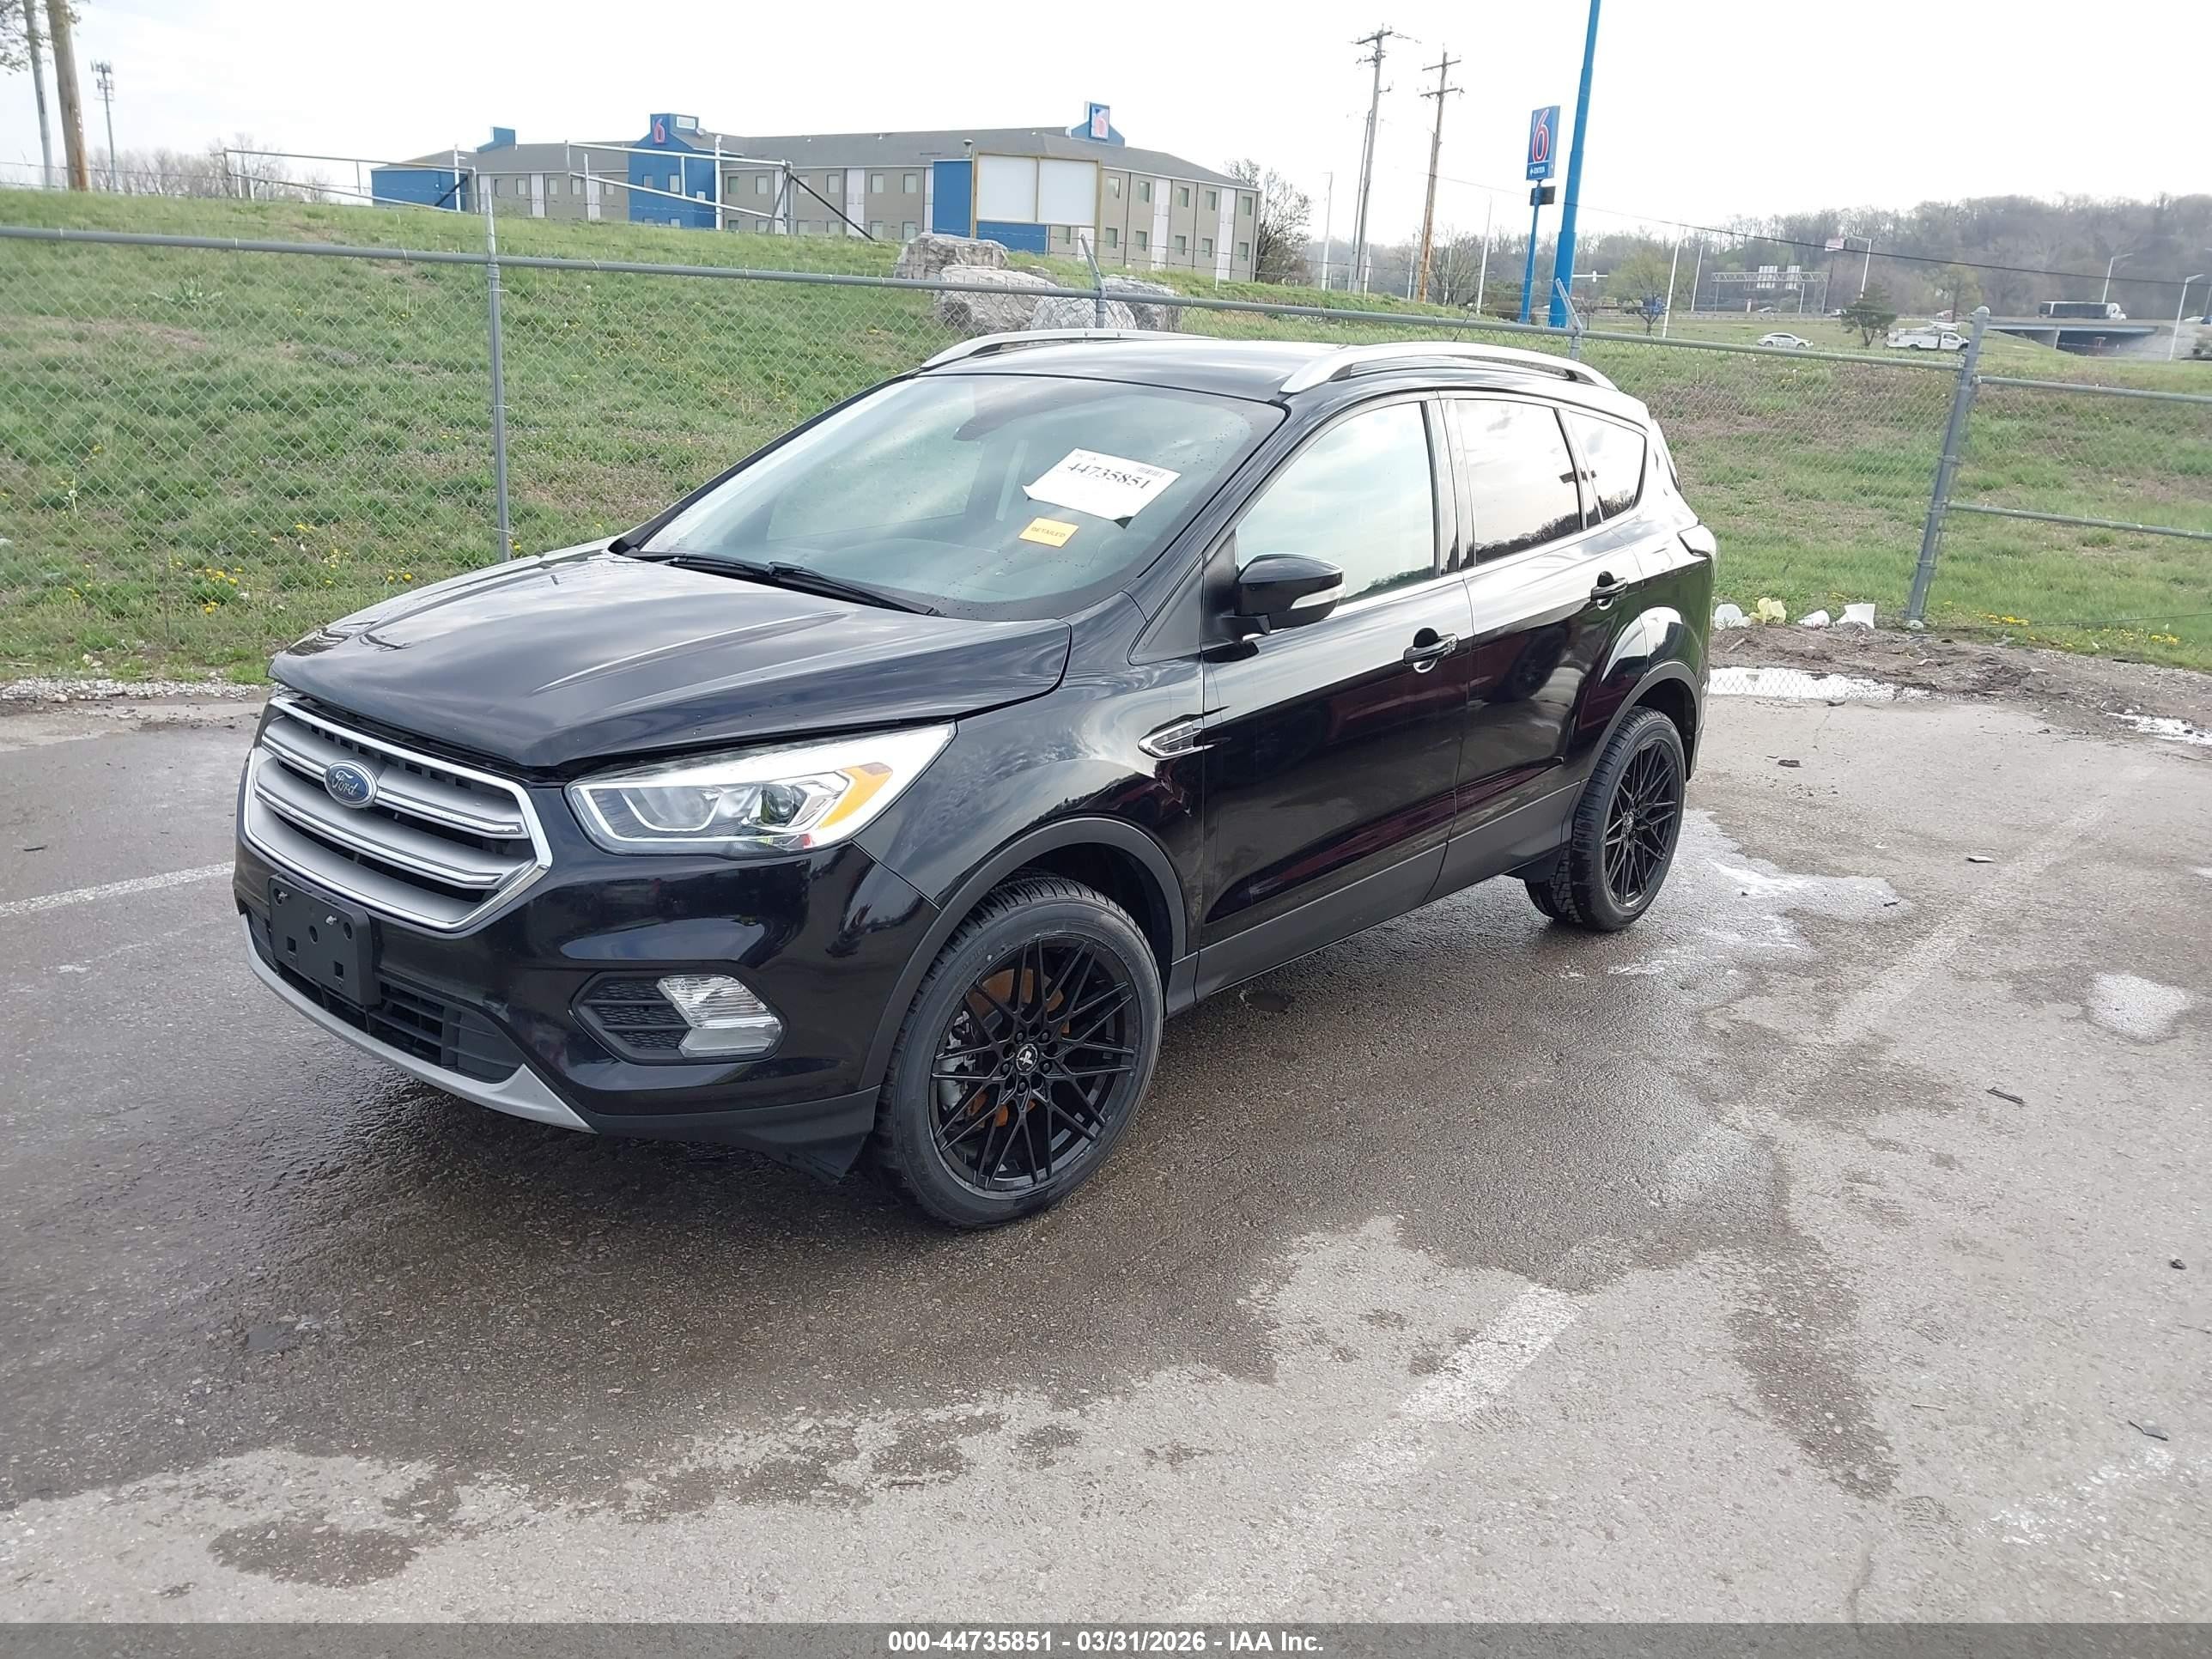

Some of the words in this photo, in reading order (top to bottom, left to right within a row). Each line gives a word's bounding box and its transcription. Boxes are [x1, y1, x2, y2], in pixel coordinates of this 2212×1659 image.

[654, 118, 665, 143] 6
[1533, 108, 1549, 163] 6
[1067, 463, 1151, 489] 44735851
[331, 770, 358, 796] Ford
